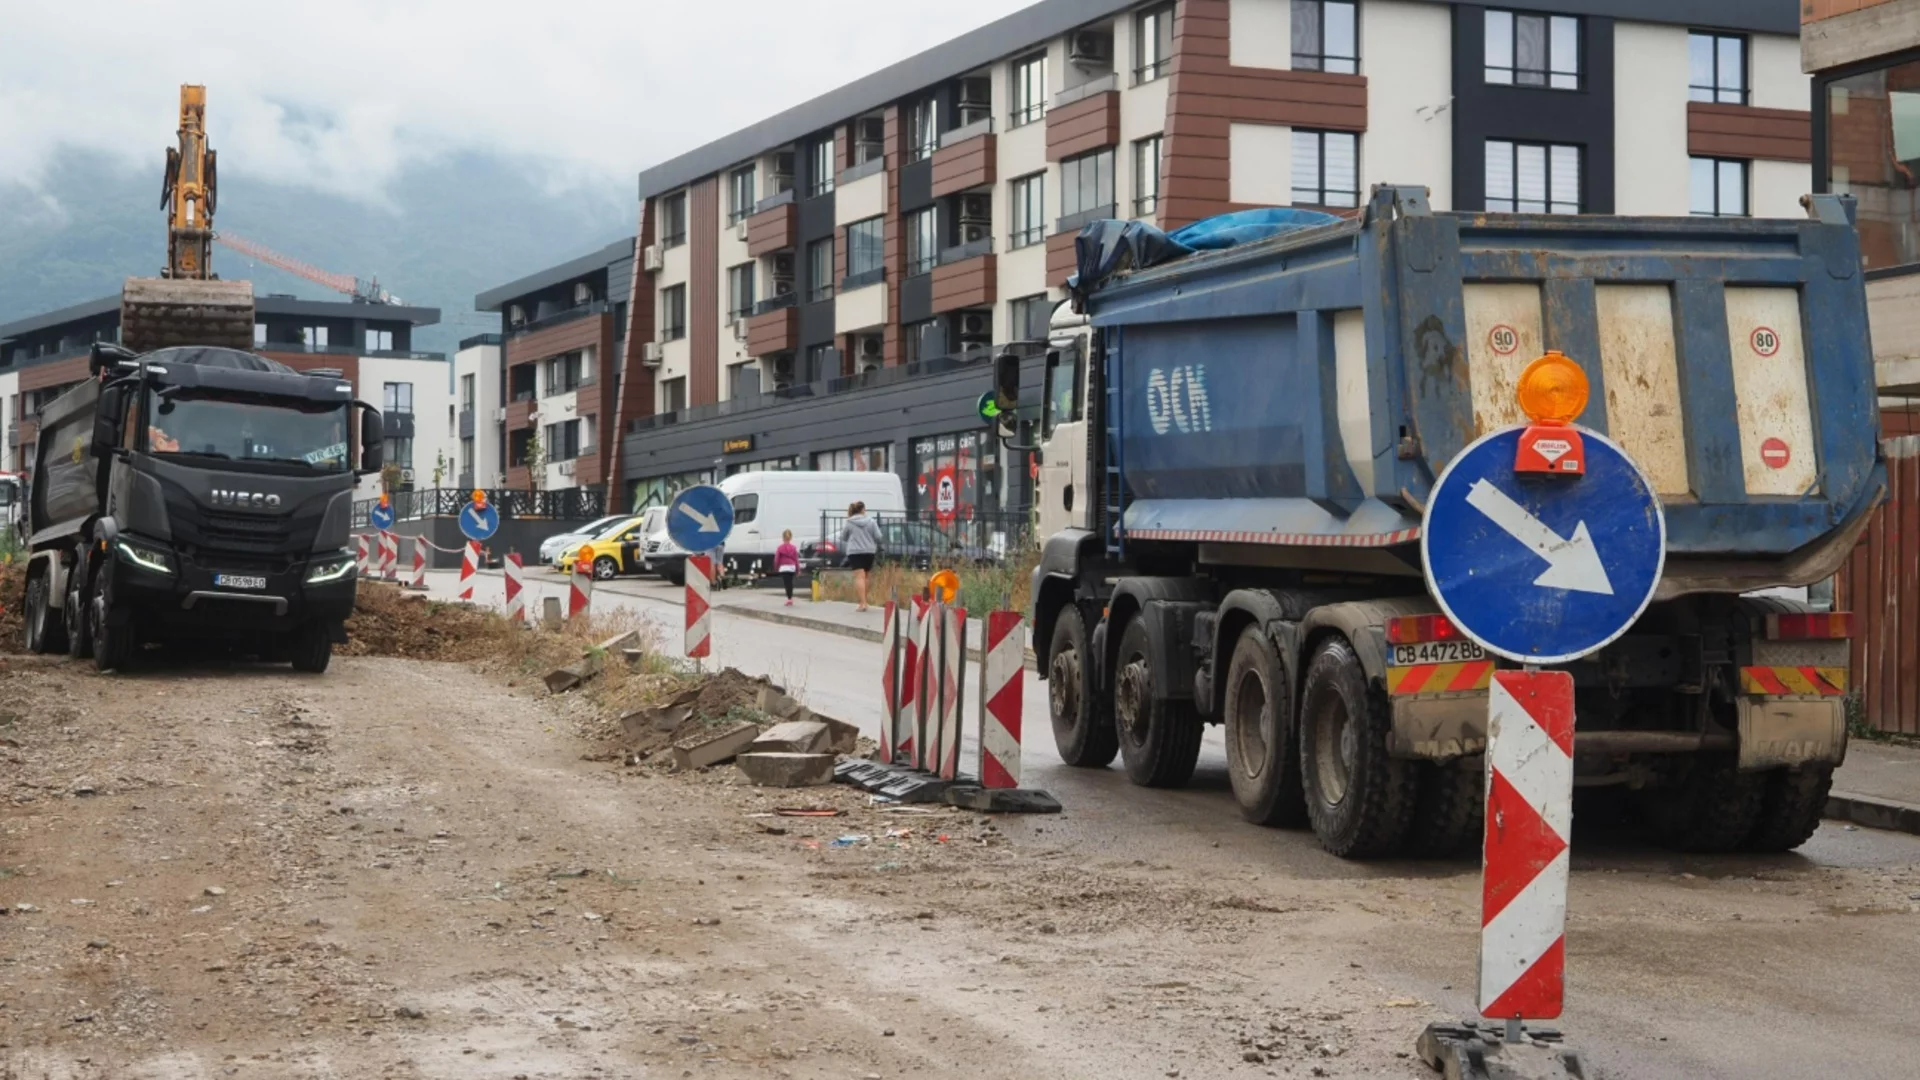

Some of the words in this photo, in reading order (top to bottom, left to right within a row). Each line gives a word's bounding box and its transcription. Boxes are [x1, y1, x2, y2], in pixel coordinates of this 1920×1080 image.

[1494, 331, 1513, 346] 90
[1756, 332, 1774, 348] 80
[211, 489, 281, 509] IVECO
[1396, 645, 1417, 664] CB
[1419, 643, 1459, 661] 4472
[1460, 641, 1483, 659] BB
